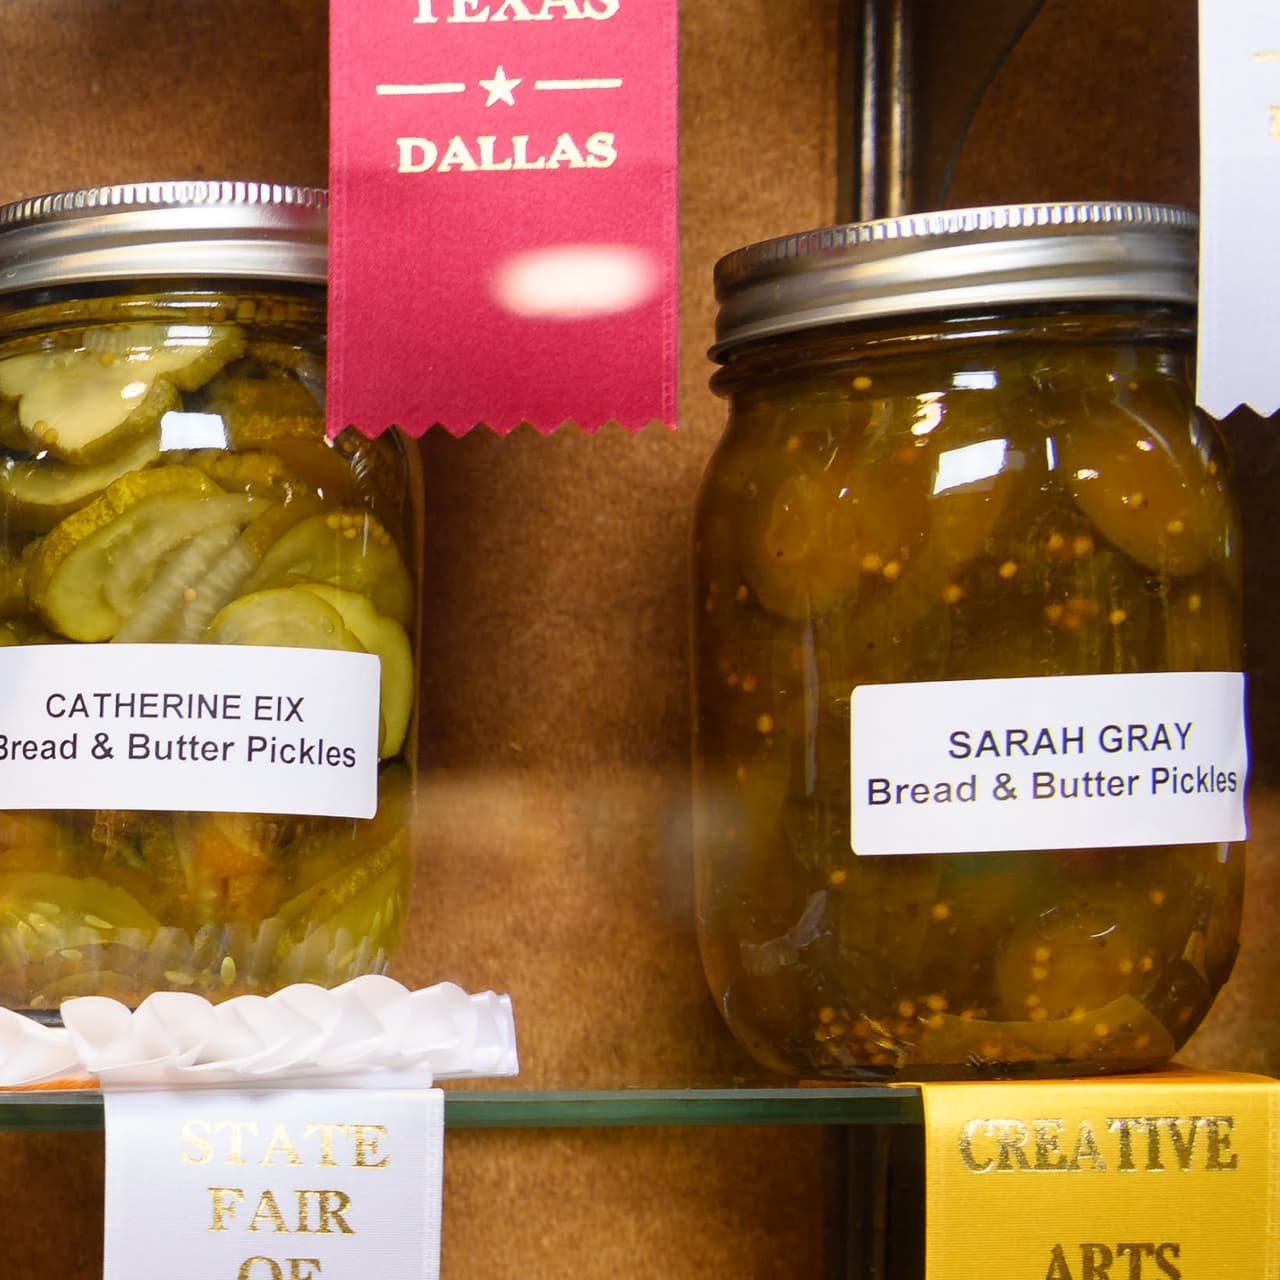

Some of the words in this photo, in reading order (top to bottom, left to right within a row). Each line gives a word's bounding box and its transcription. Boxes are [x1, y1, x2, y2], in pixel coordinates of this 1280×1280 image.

[396, 131, 617, 174] DALLAS
[45, 693, 241, 720] CATHERINE
[254, 695, 305, 722] EIX
[91, 732, 114, 760] &
[127, 733, 235, 762] Butter
[246, 735, 357, 768] Pickles
[948, 726, 1084, 759] SARAH
[1098, 722, 1193, 754] GRAY
[867, 774, 977, 806] Bread
[992, 772, 1017, 801] &
[1032, 770, 1140, 800] Butter
[1151, 764, 1238, 795] Pickles
[180, 1119, 390, 1169] STATE
[958, 1116, 1239, 1174] CREATIVE
[207, 1187, 357, 1235] FAIR
